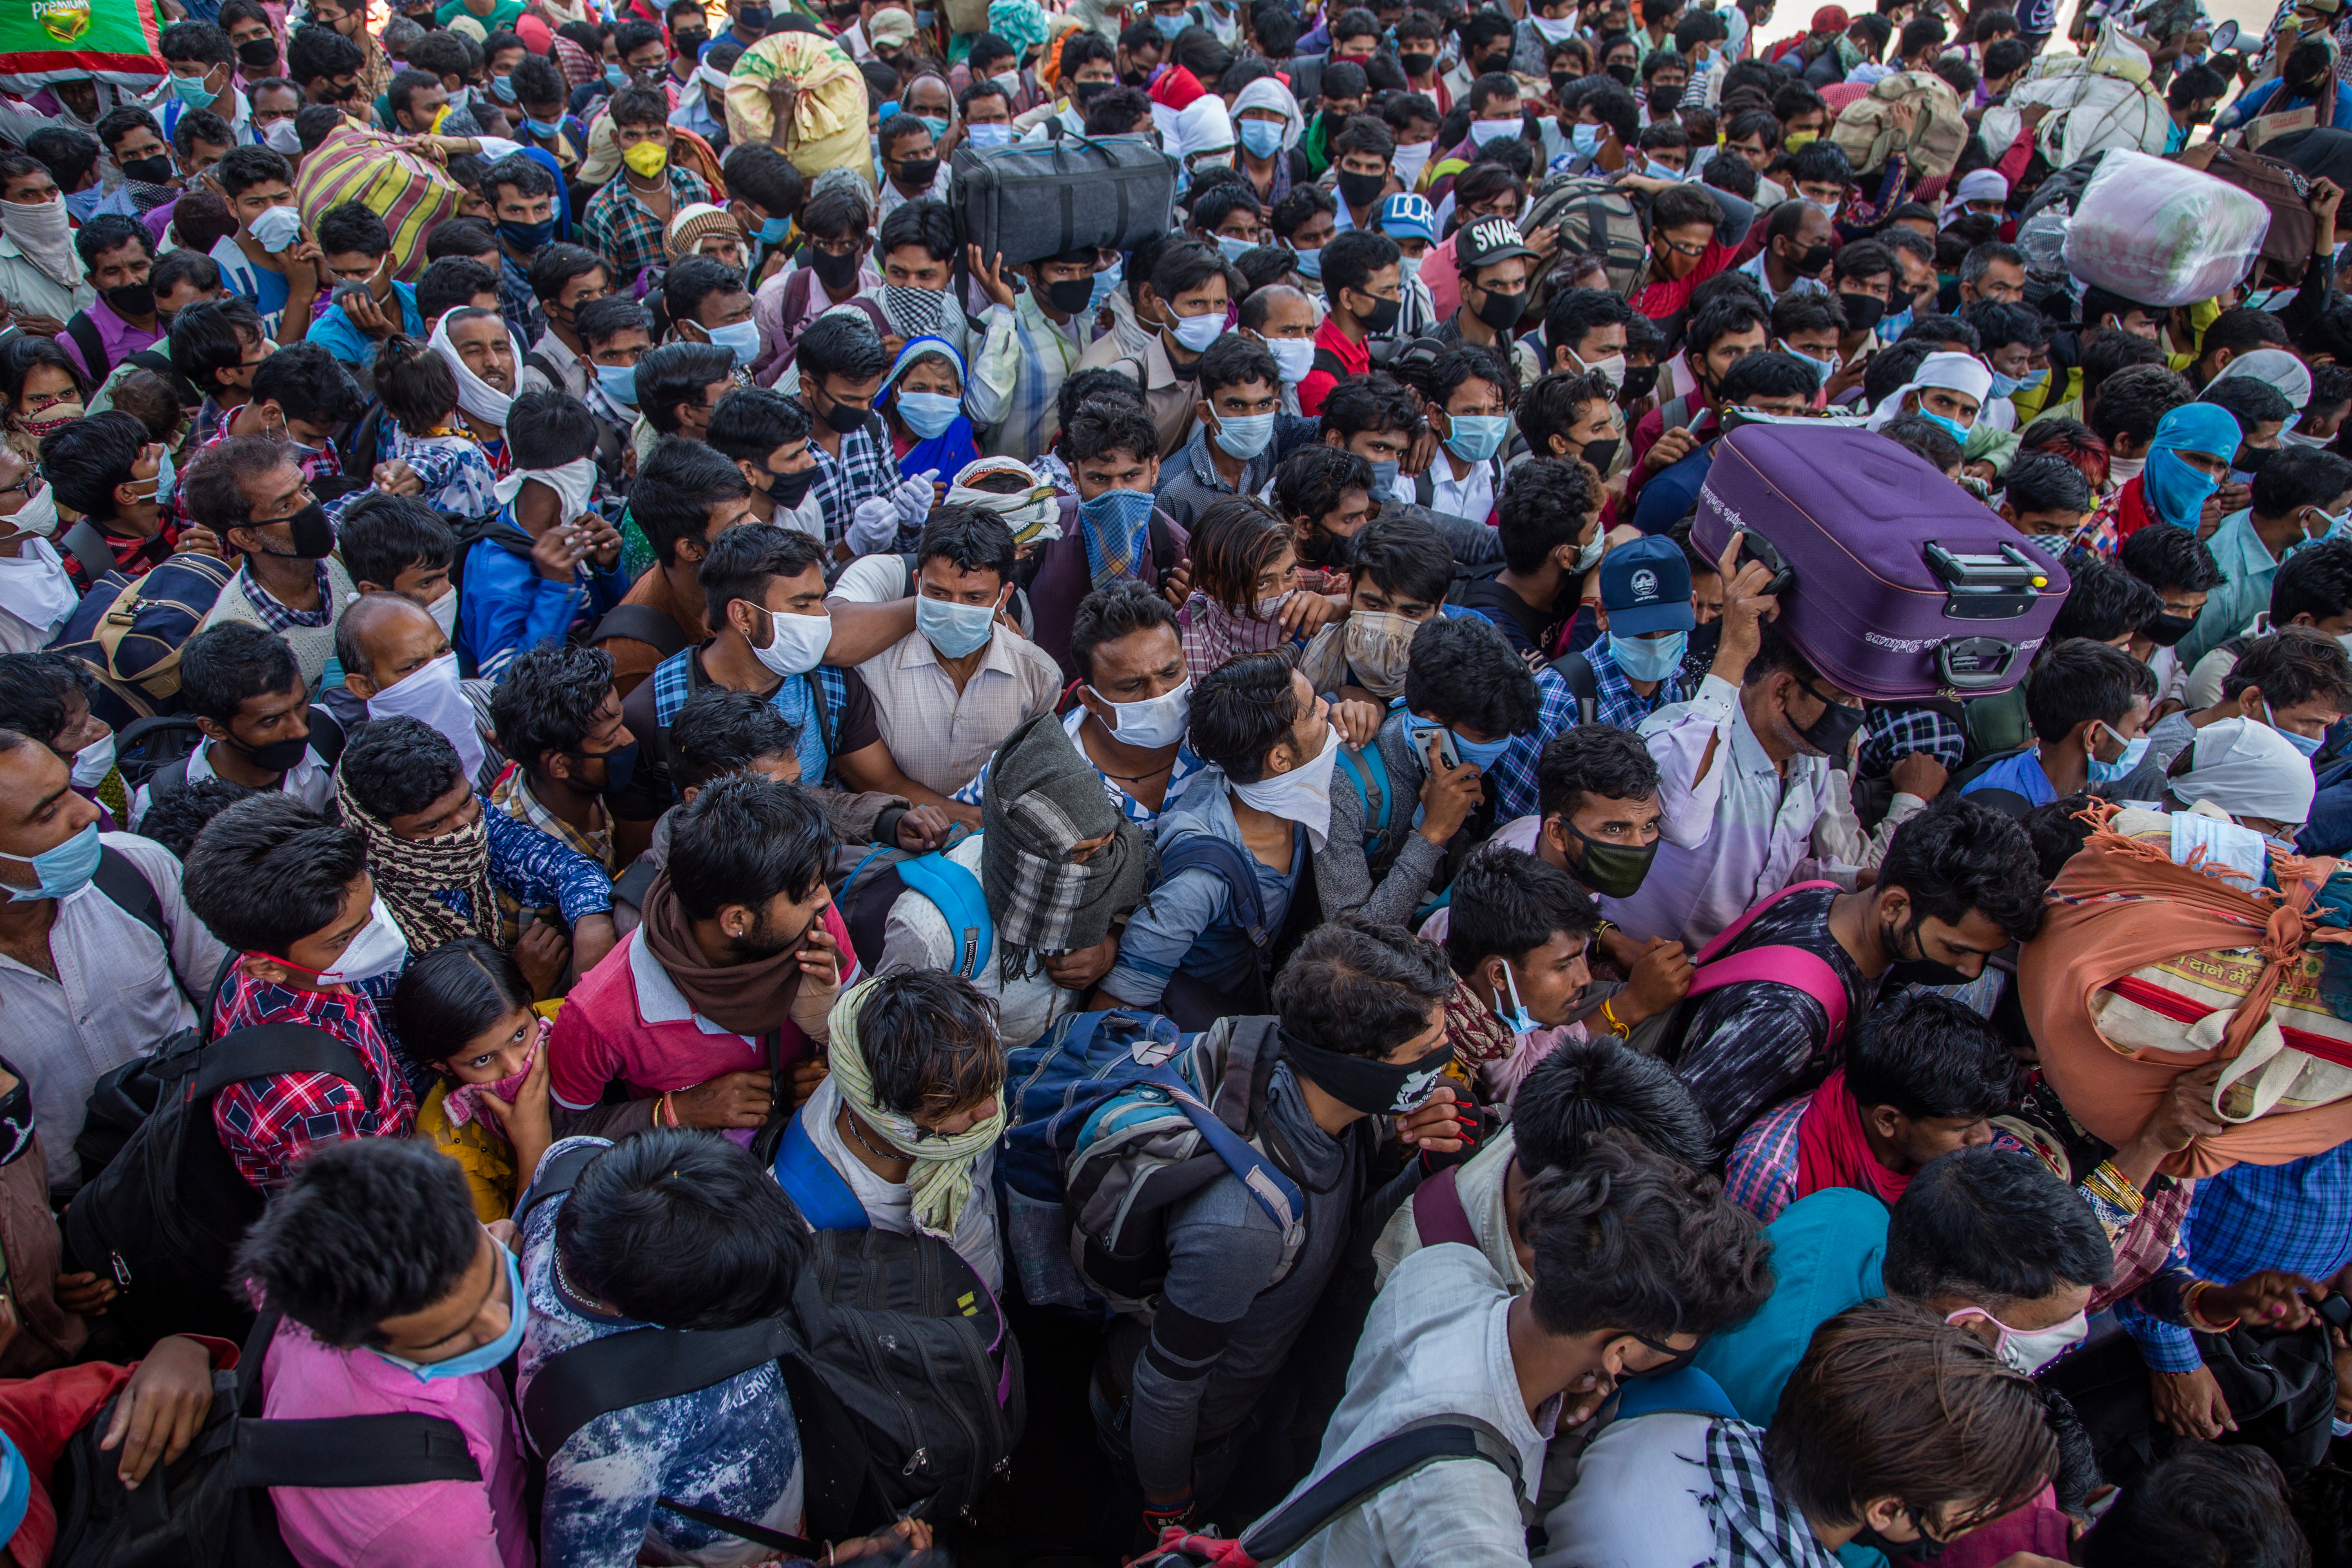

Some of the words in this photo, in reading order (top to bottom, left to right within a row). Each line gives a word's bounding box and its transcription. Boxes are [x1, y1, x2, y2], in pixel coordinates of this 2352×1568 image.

[1392, 194, 1435, 232] DOPE
[1472, 218, 1524, 252] SWAG
[1866, 632, 1922, 653] Deluxe
[965, 943, 974, 971] COLLECTION
[2189, 958, 2225, 979] दाने
[2228, 967, 2252, 985] में
